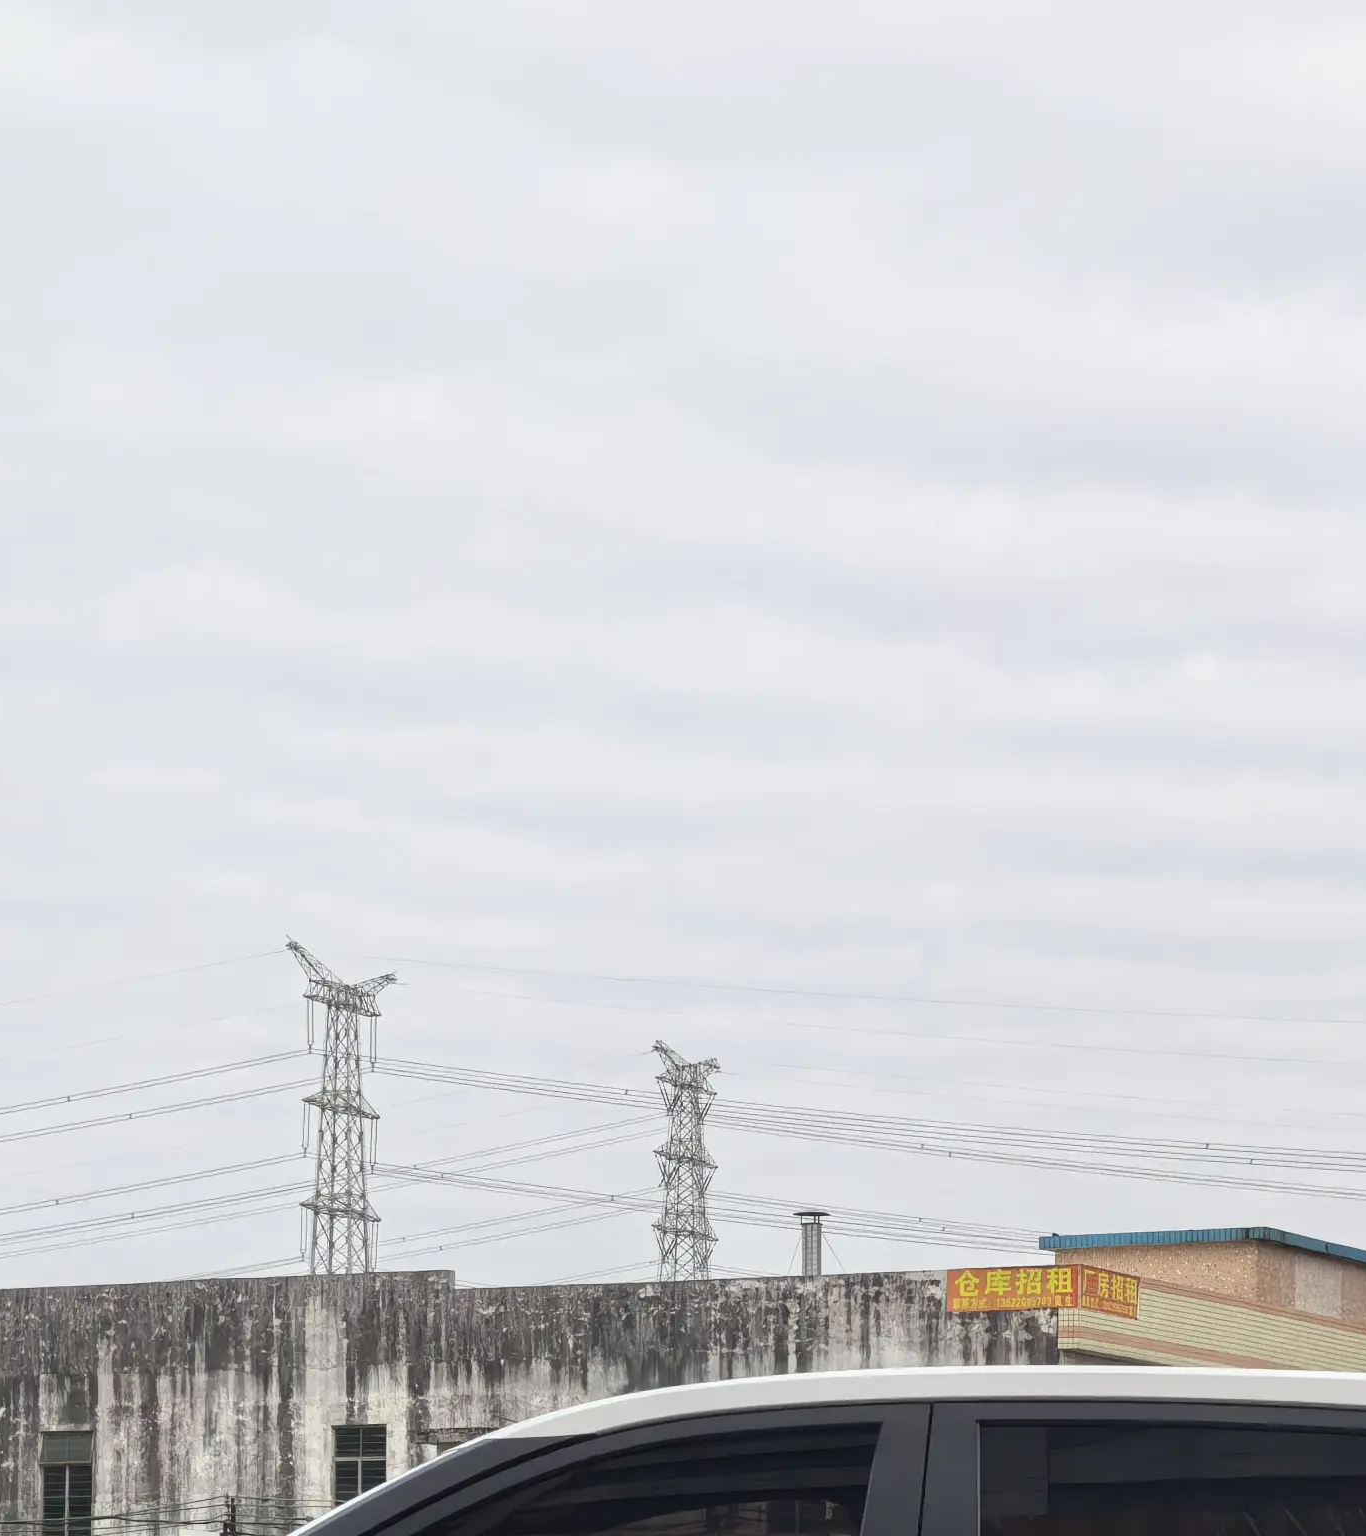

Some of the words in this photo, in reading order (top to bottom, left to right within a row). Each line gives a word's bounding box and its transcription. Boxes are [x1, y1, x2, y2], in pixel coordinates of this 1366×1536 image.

[955, 1267, 1073, 1296] 仓库招租
[1082, 1269, 1138, 1304] 厂房招租
